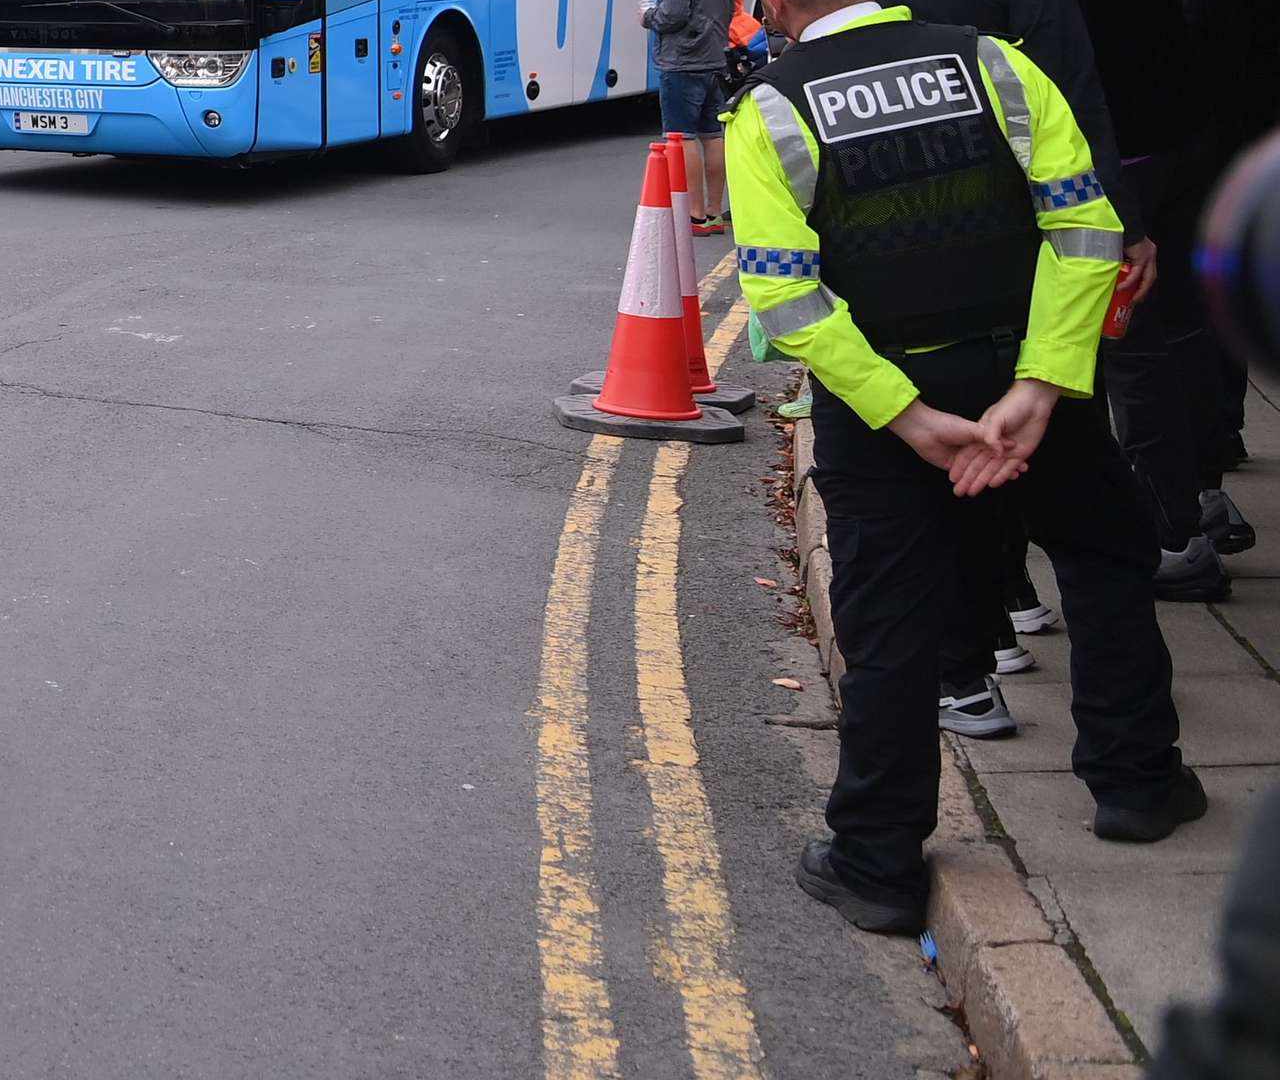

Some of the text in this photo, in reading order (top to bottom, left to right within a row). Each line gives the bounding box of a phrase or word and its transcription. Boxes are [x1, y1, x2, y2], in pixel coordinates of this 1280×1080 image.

[81, 60, 136, 81] TIRE
[75, 89, 103, 110] CITY
[818, 67, 967, 127] POLICE
[31, 115, 68, 129] WSM 3
